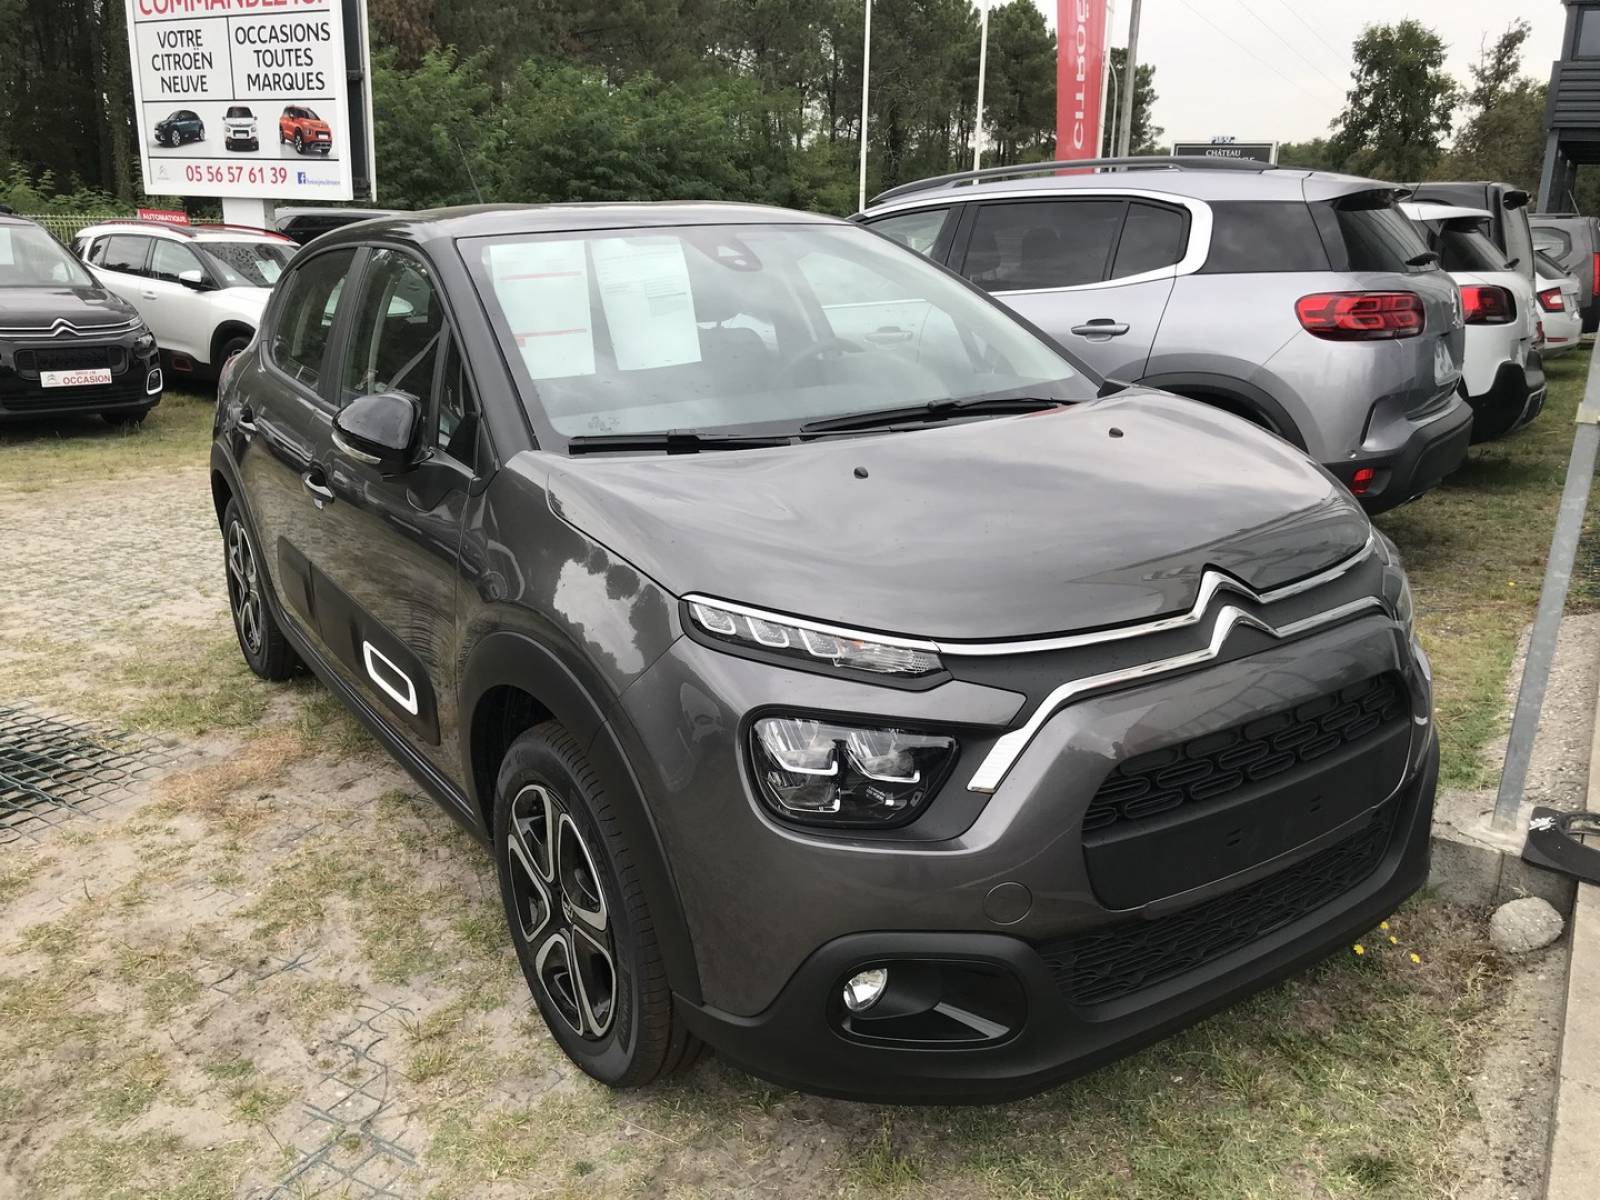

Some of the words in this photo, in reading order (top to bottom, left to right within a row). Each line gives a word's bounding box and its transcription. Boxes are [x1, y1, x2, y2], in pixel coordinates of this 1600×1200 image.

[139, 0, 288, 15] COMMA
[157, 29, 203, 48] VOTRE
[235, 22, 331, 44] OCCASIONS
[151, 47, 213, 71] CITROËN
[254, 48, 313, 67] TOUTES
[161, 75, 208, 93] NEUVE
[247, 71, 325, 92] MARQUES
[186, 165, 203, 182] 05
[207, 165, 223, 182] 56
[227, 166, 243, 183] 57
[248, 167, 265, 183] 61
[270, 167, 287, 184] 39
[142, 213, 187, 222] AUTOMATIQUE
[63, 375, 111, 385] OCCASION
